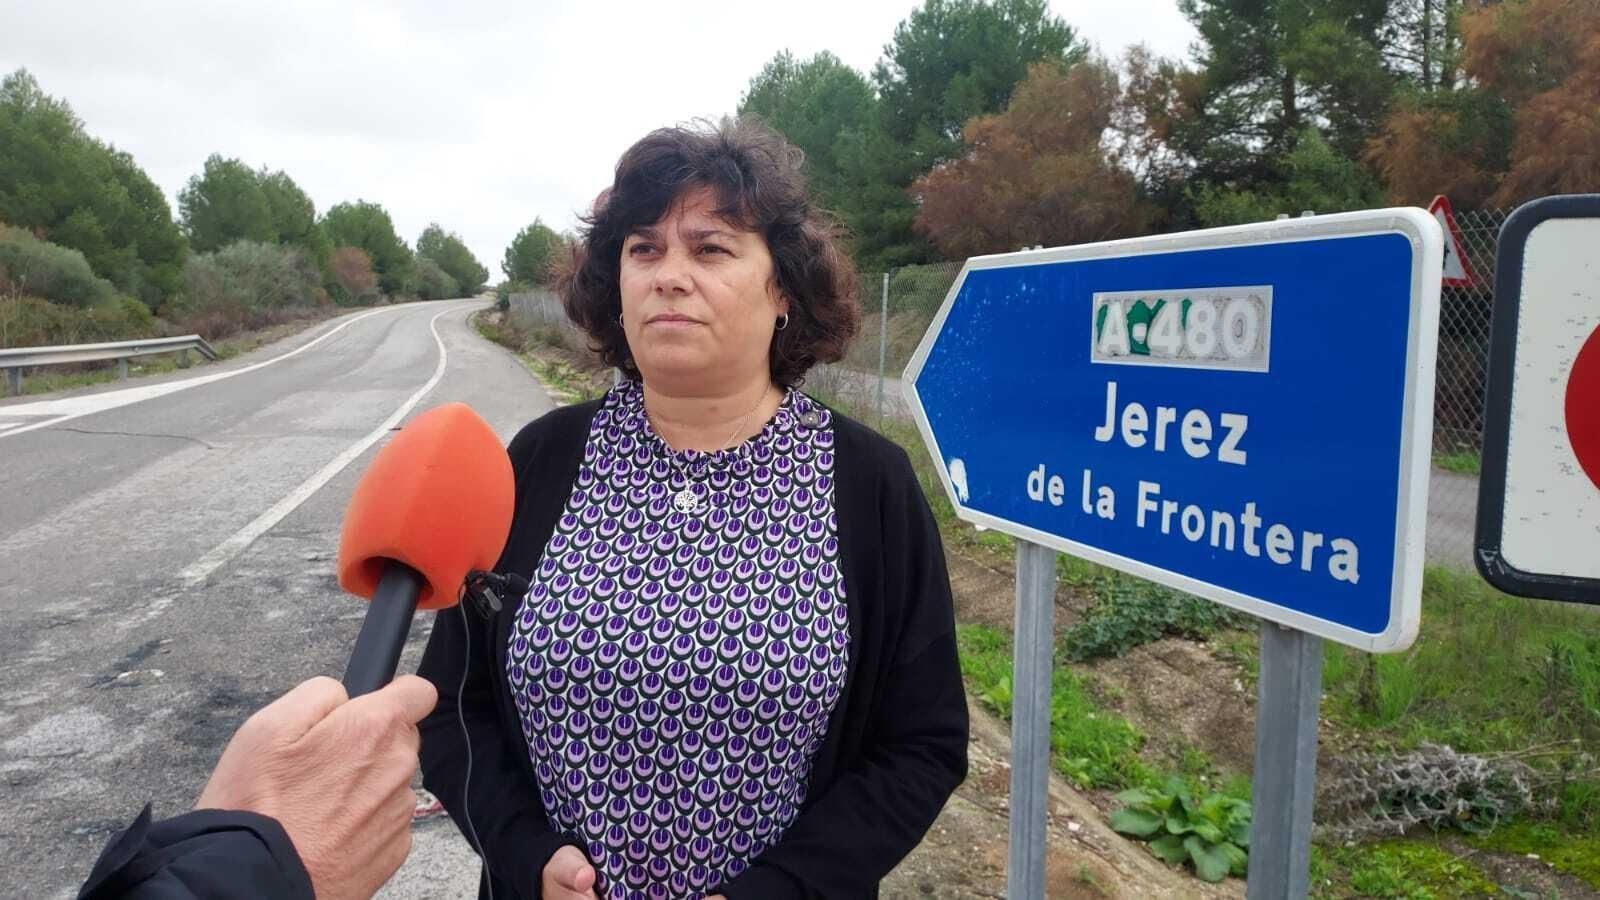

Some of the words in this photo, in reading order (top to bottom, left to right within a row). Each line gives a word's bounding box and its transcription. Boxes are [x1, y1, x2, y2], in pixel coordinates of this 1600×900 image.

[1098, 299, 1258, 358] A-480
[1095, 381, 1248, 465] Jerez
[1027, 463, 1065, 506] de
[1081, 469, 1115, 520] la
[1136, 480, 1360, 584] Frontera
